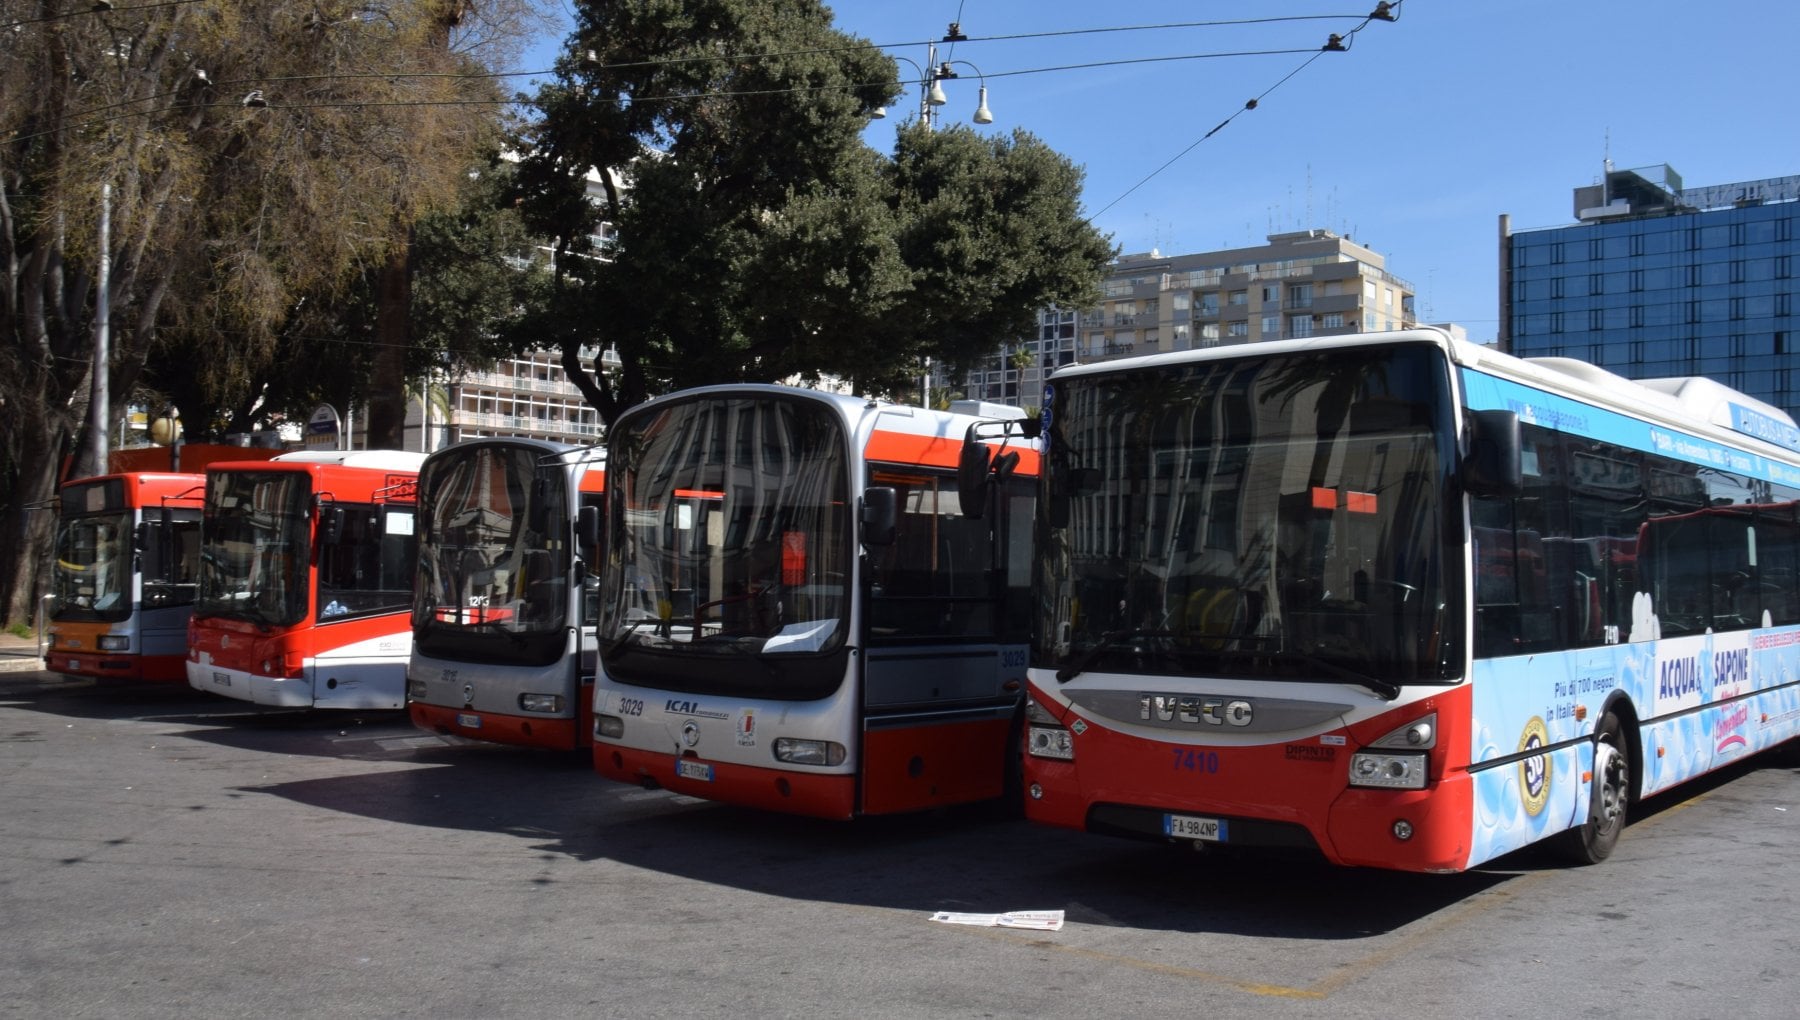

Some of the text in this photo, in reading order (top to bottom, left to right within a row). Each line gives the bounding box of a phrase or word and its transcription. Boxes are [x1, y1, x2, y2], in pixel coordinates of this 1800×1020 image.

[1002, 650, 1025, 668] 3029
[1659, 656, 1695, 699] ACQUA
[1696, 665, 1703, 694] &
[1714, 648, 1748, 686] SAPONE
[1569, 680, 1576, 696] di
[1577, 678, 1591, 694] 700
[1593, 675, 1615, 693] negozi
[619, 698, 644, 717] 3029
[665, 699, 699, 714] ICAI
[1141, 695, 1254, 728] IVECO
[1546, 703, 1576, 722] in Italia
[1286, 744, 1335, 756] DIPINTO
[1172, 748, 1219, 775] 7410
[1172, 818, 1218, 837] FA 984NP
